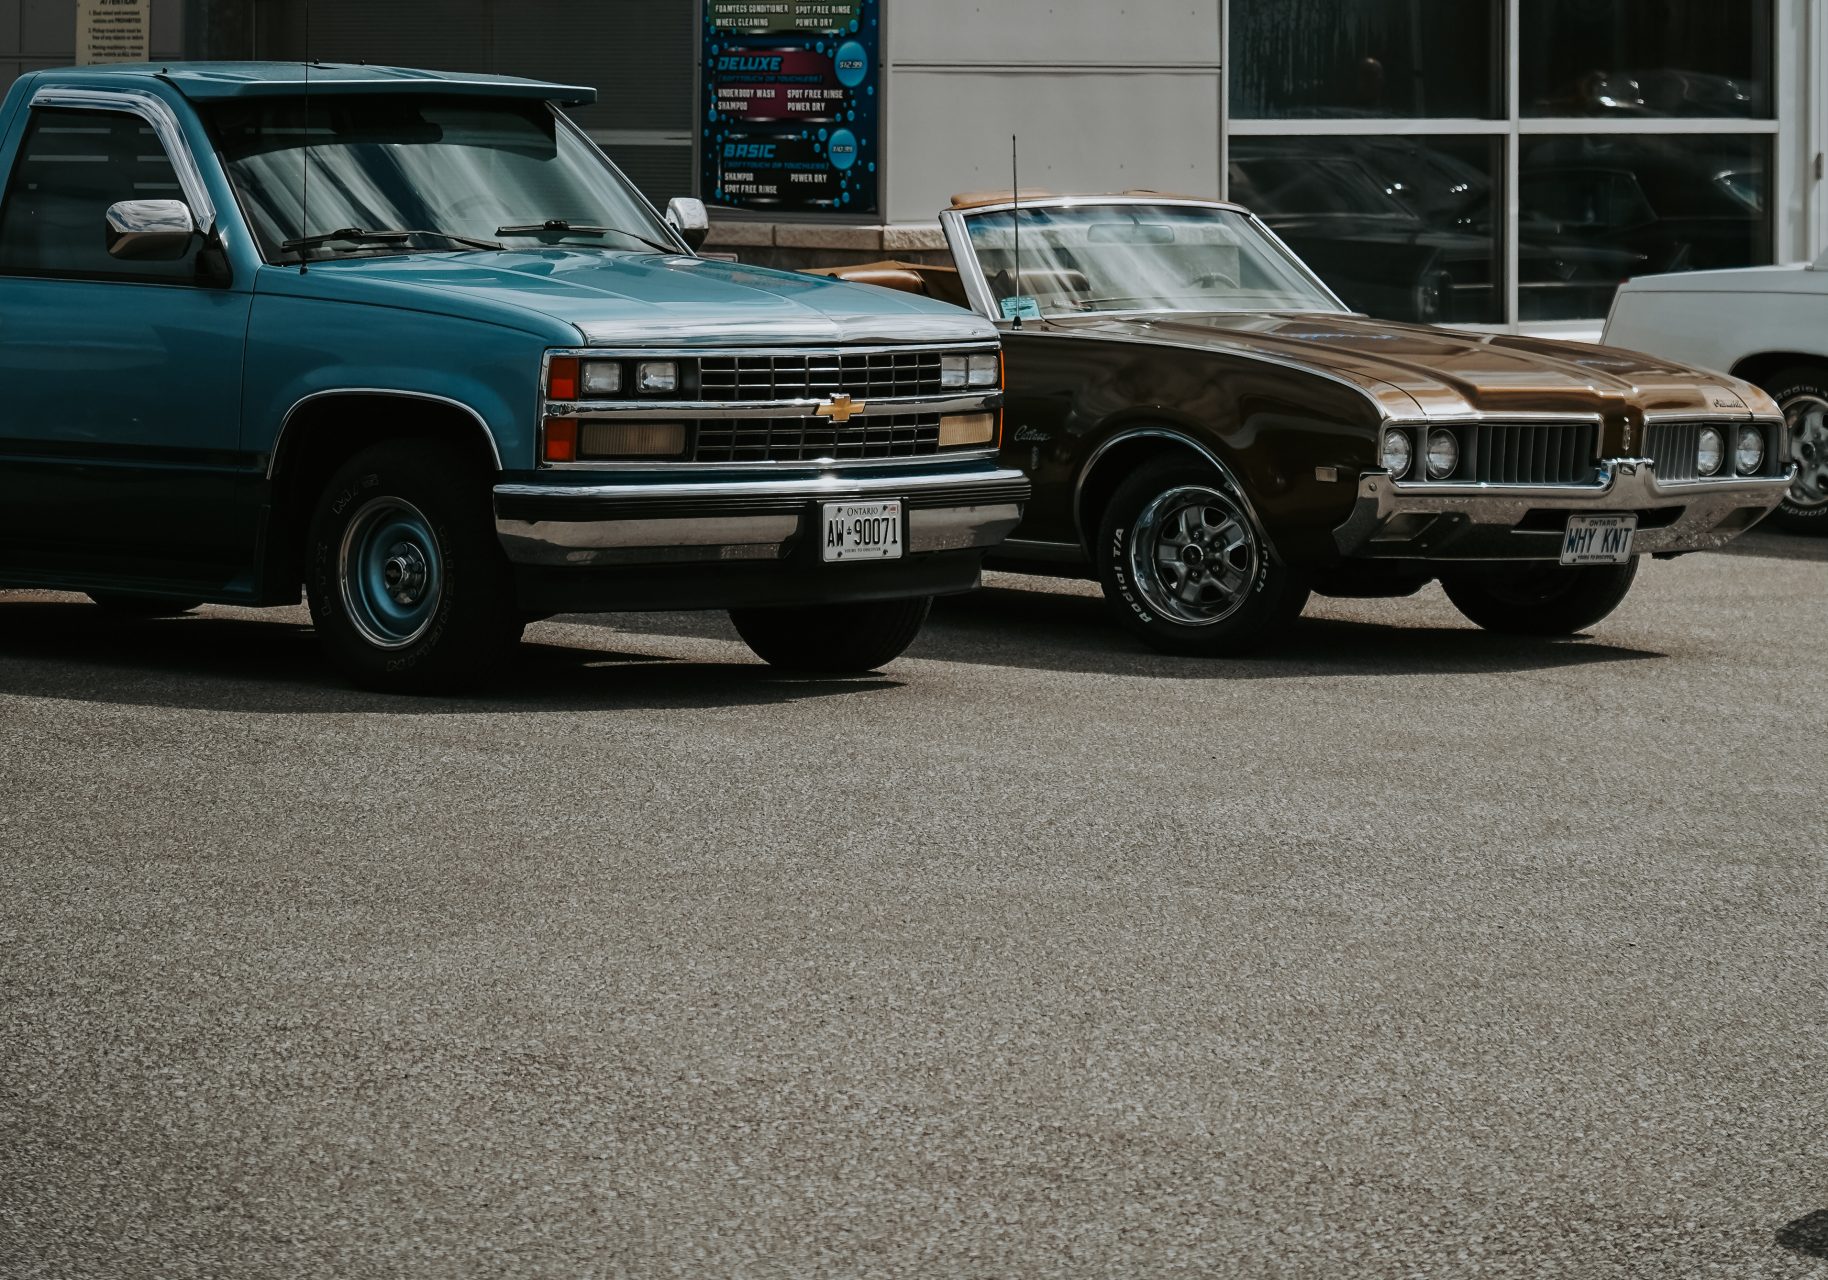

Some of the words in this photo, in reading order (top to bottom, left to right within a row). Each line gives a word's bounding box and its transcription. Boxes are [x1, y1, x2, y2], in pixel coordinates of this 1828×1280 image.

[715, 4, 748, 13] FOAMTECS
[749, 4, 788, 13] CONDITIONER
[795, 5, 810, 14] SPOT
[812, 5, 829, 14] FREE
[831, 5, 851, 14] RINSE
[715, 18, 736, 27] WHEEL
[738, 18, 769, 27] CLEANING
[795, 18, 818, 27] POWER
[820, 18, 833, 27] DRY
[717, 56, 782, 71] DELUXE
[718, 89, 754, 98] UNDERBODY
[756, 89, 776, 98] WASH
[787, 89, 803, 99] SPOT
[804, 89, 822, 99] FREE
[824, 89, 844, 99] RINSE
[717, 101, 748, 111] SHAMPOO
[787, 102, 810, 111] POWER
[812, 102, 826, 111] DRY
[723, 144, 776, 158] BASIC
[724, 172, 754, 181] SHAMPOO
[790, 173, 812, 183] POWER
[814, 173, 827, 183] DRY
[724, 184, 740, 194] SPOT
[741, 184, 757, 194] FREE
[758, 184, 777, 194] RINSE
[847, 507, 878, 517] ONTARIO
[827, 519, 844, 547] AW
[854, 517, 898, 546] 90071
[1113, 528, 1124, 558] T/A
[1565, 528, 1597, 553] WHY
[1600, 528, 1632, 553] KNT
